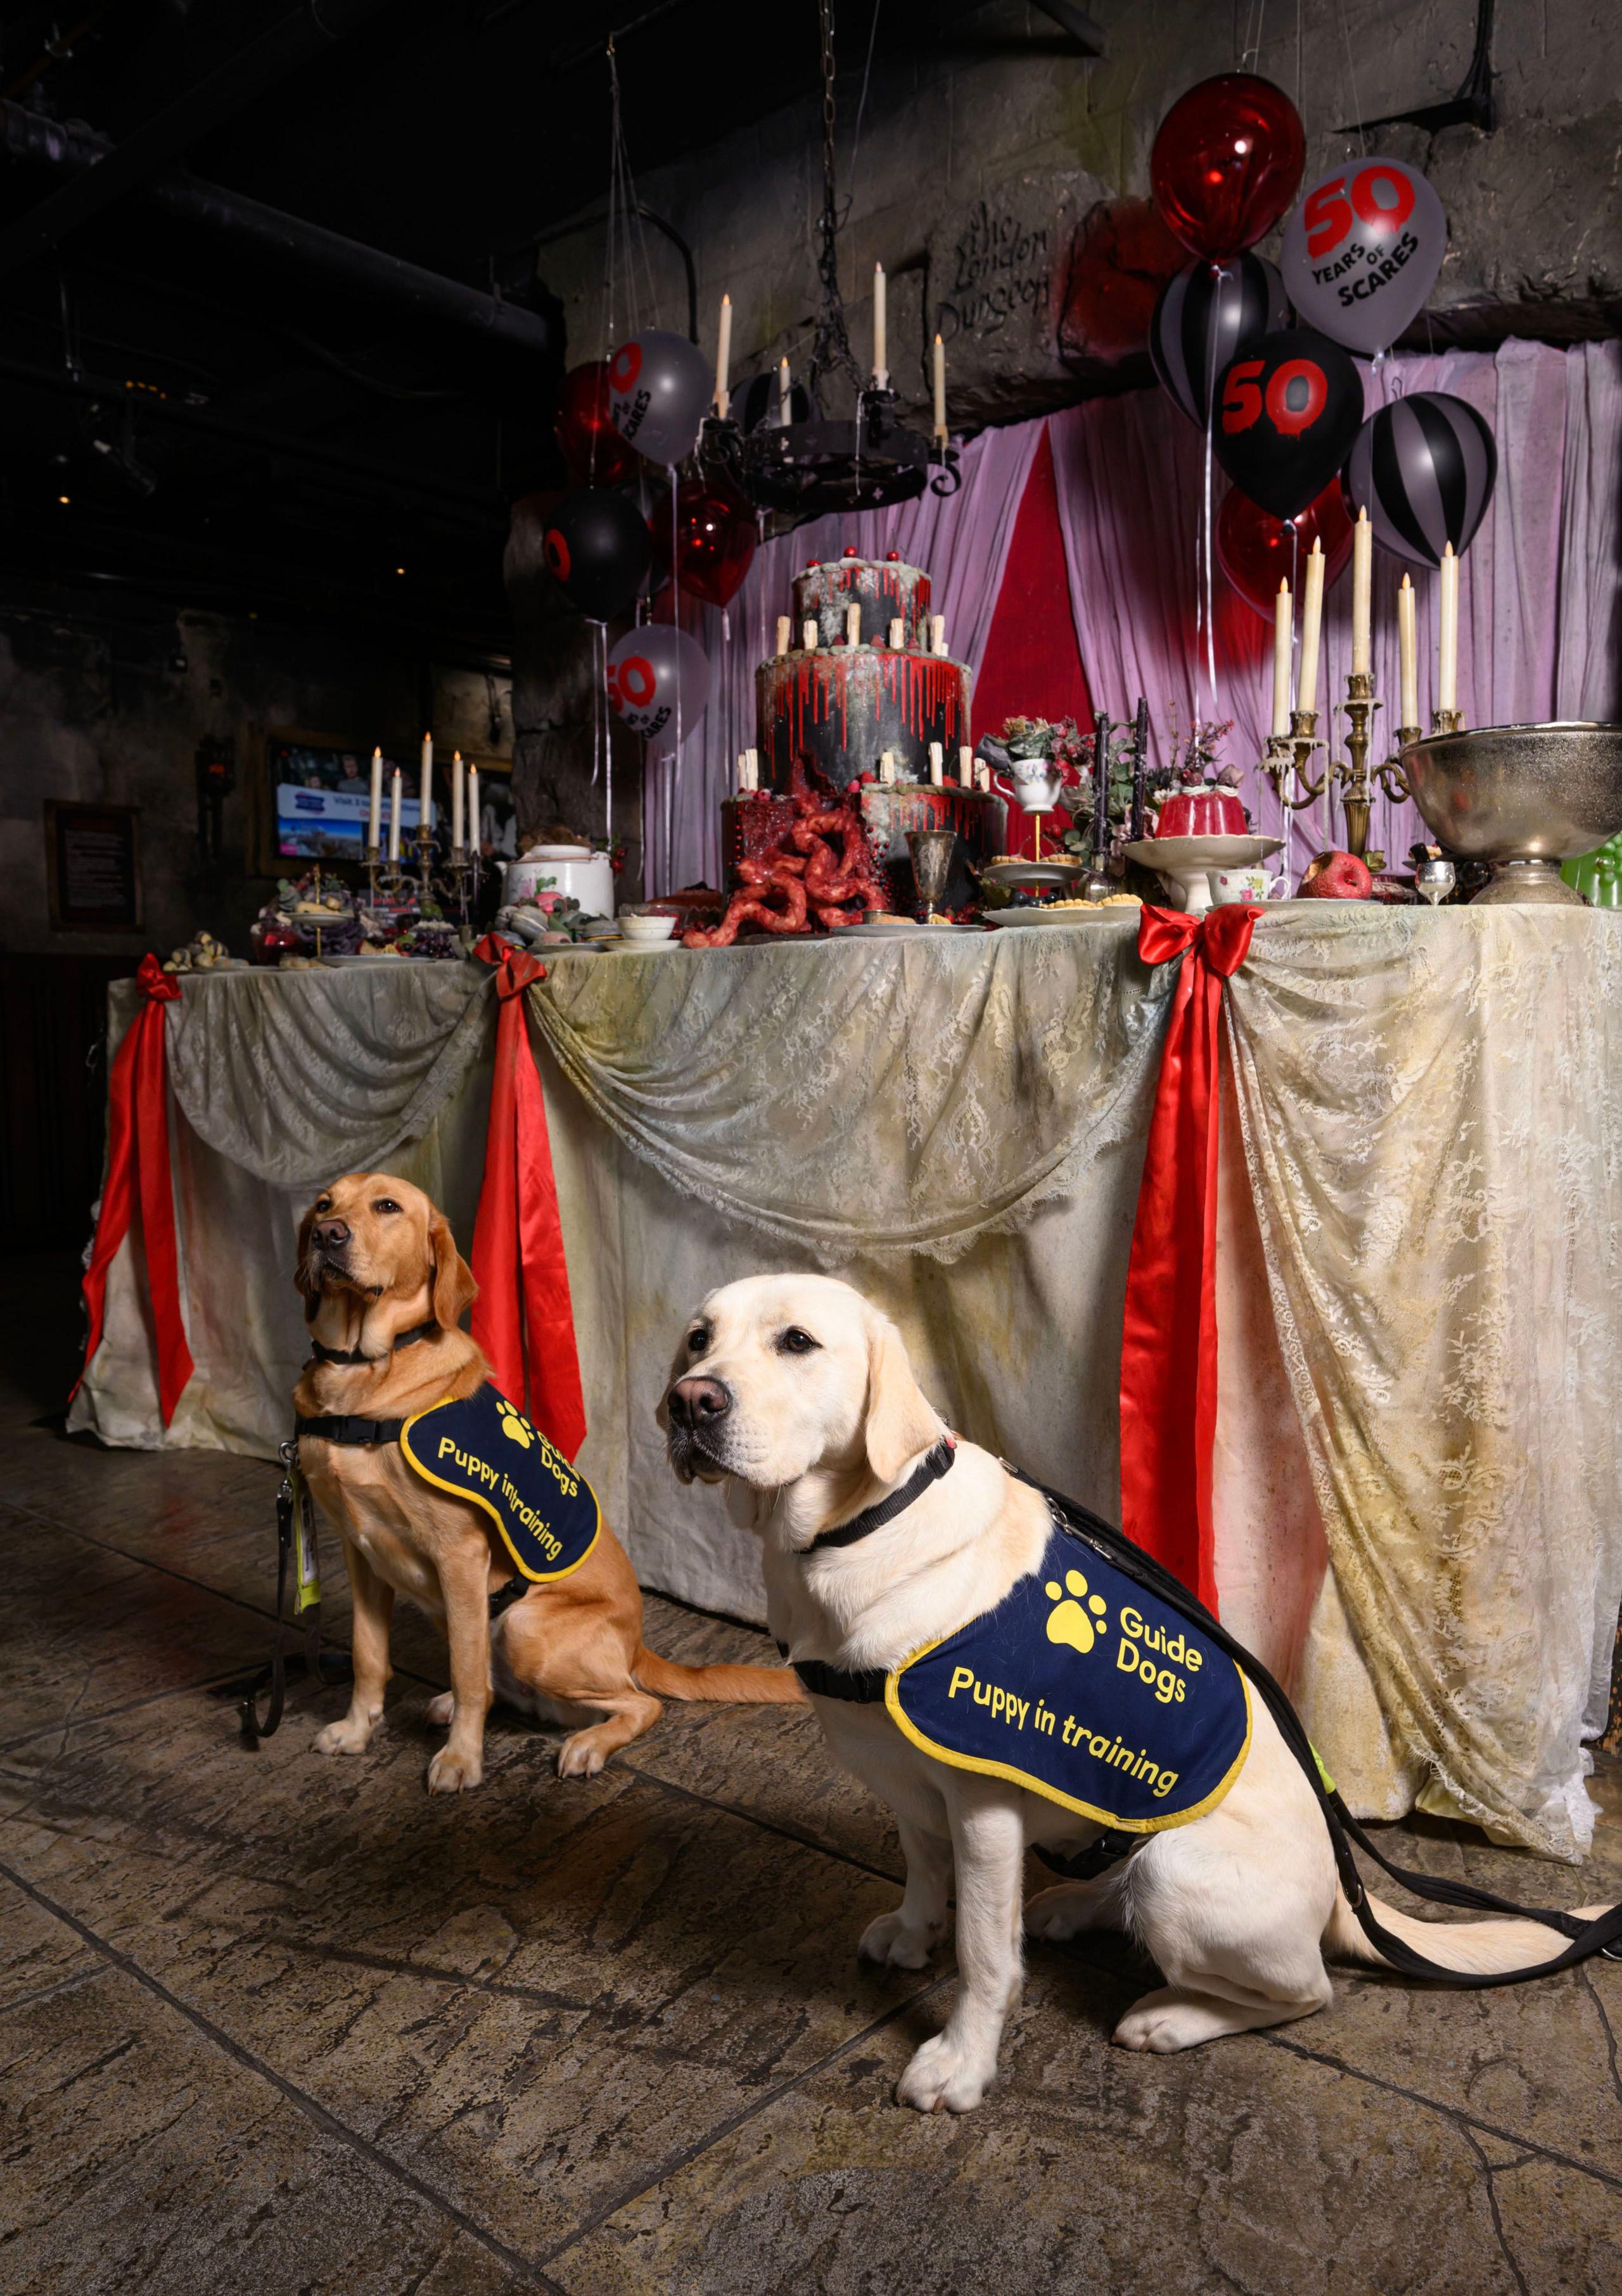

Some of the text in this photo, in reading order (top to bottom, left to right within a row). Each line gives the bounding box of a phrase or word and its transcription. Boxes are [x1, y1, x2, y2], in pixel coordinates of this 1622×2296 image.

[1303, 165, 1417, 262] 50
[1312, 243, 1384, 285] YEARS OF
[1338, 231, 1419, 307] SCARES
[937, 274, 1049, 343] Dungeon
[1221, 359, 1329, 439] 50
[437, 1437, 563, 1562] Puppy in training
[542, 1446, 578, 1498] Dogs
[1116, 1637, 1186, 1704] Dogs
[1120, 1607, 1203, 1672] Guide
[947, 1666, 1180, 1798] Puppy in training
